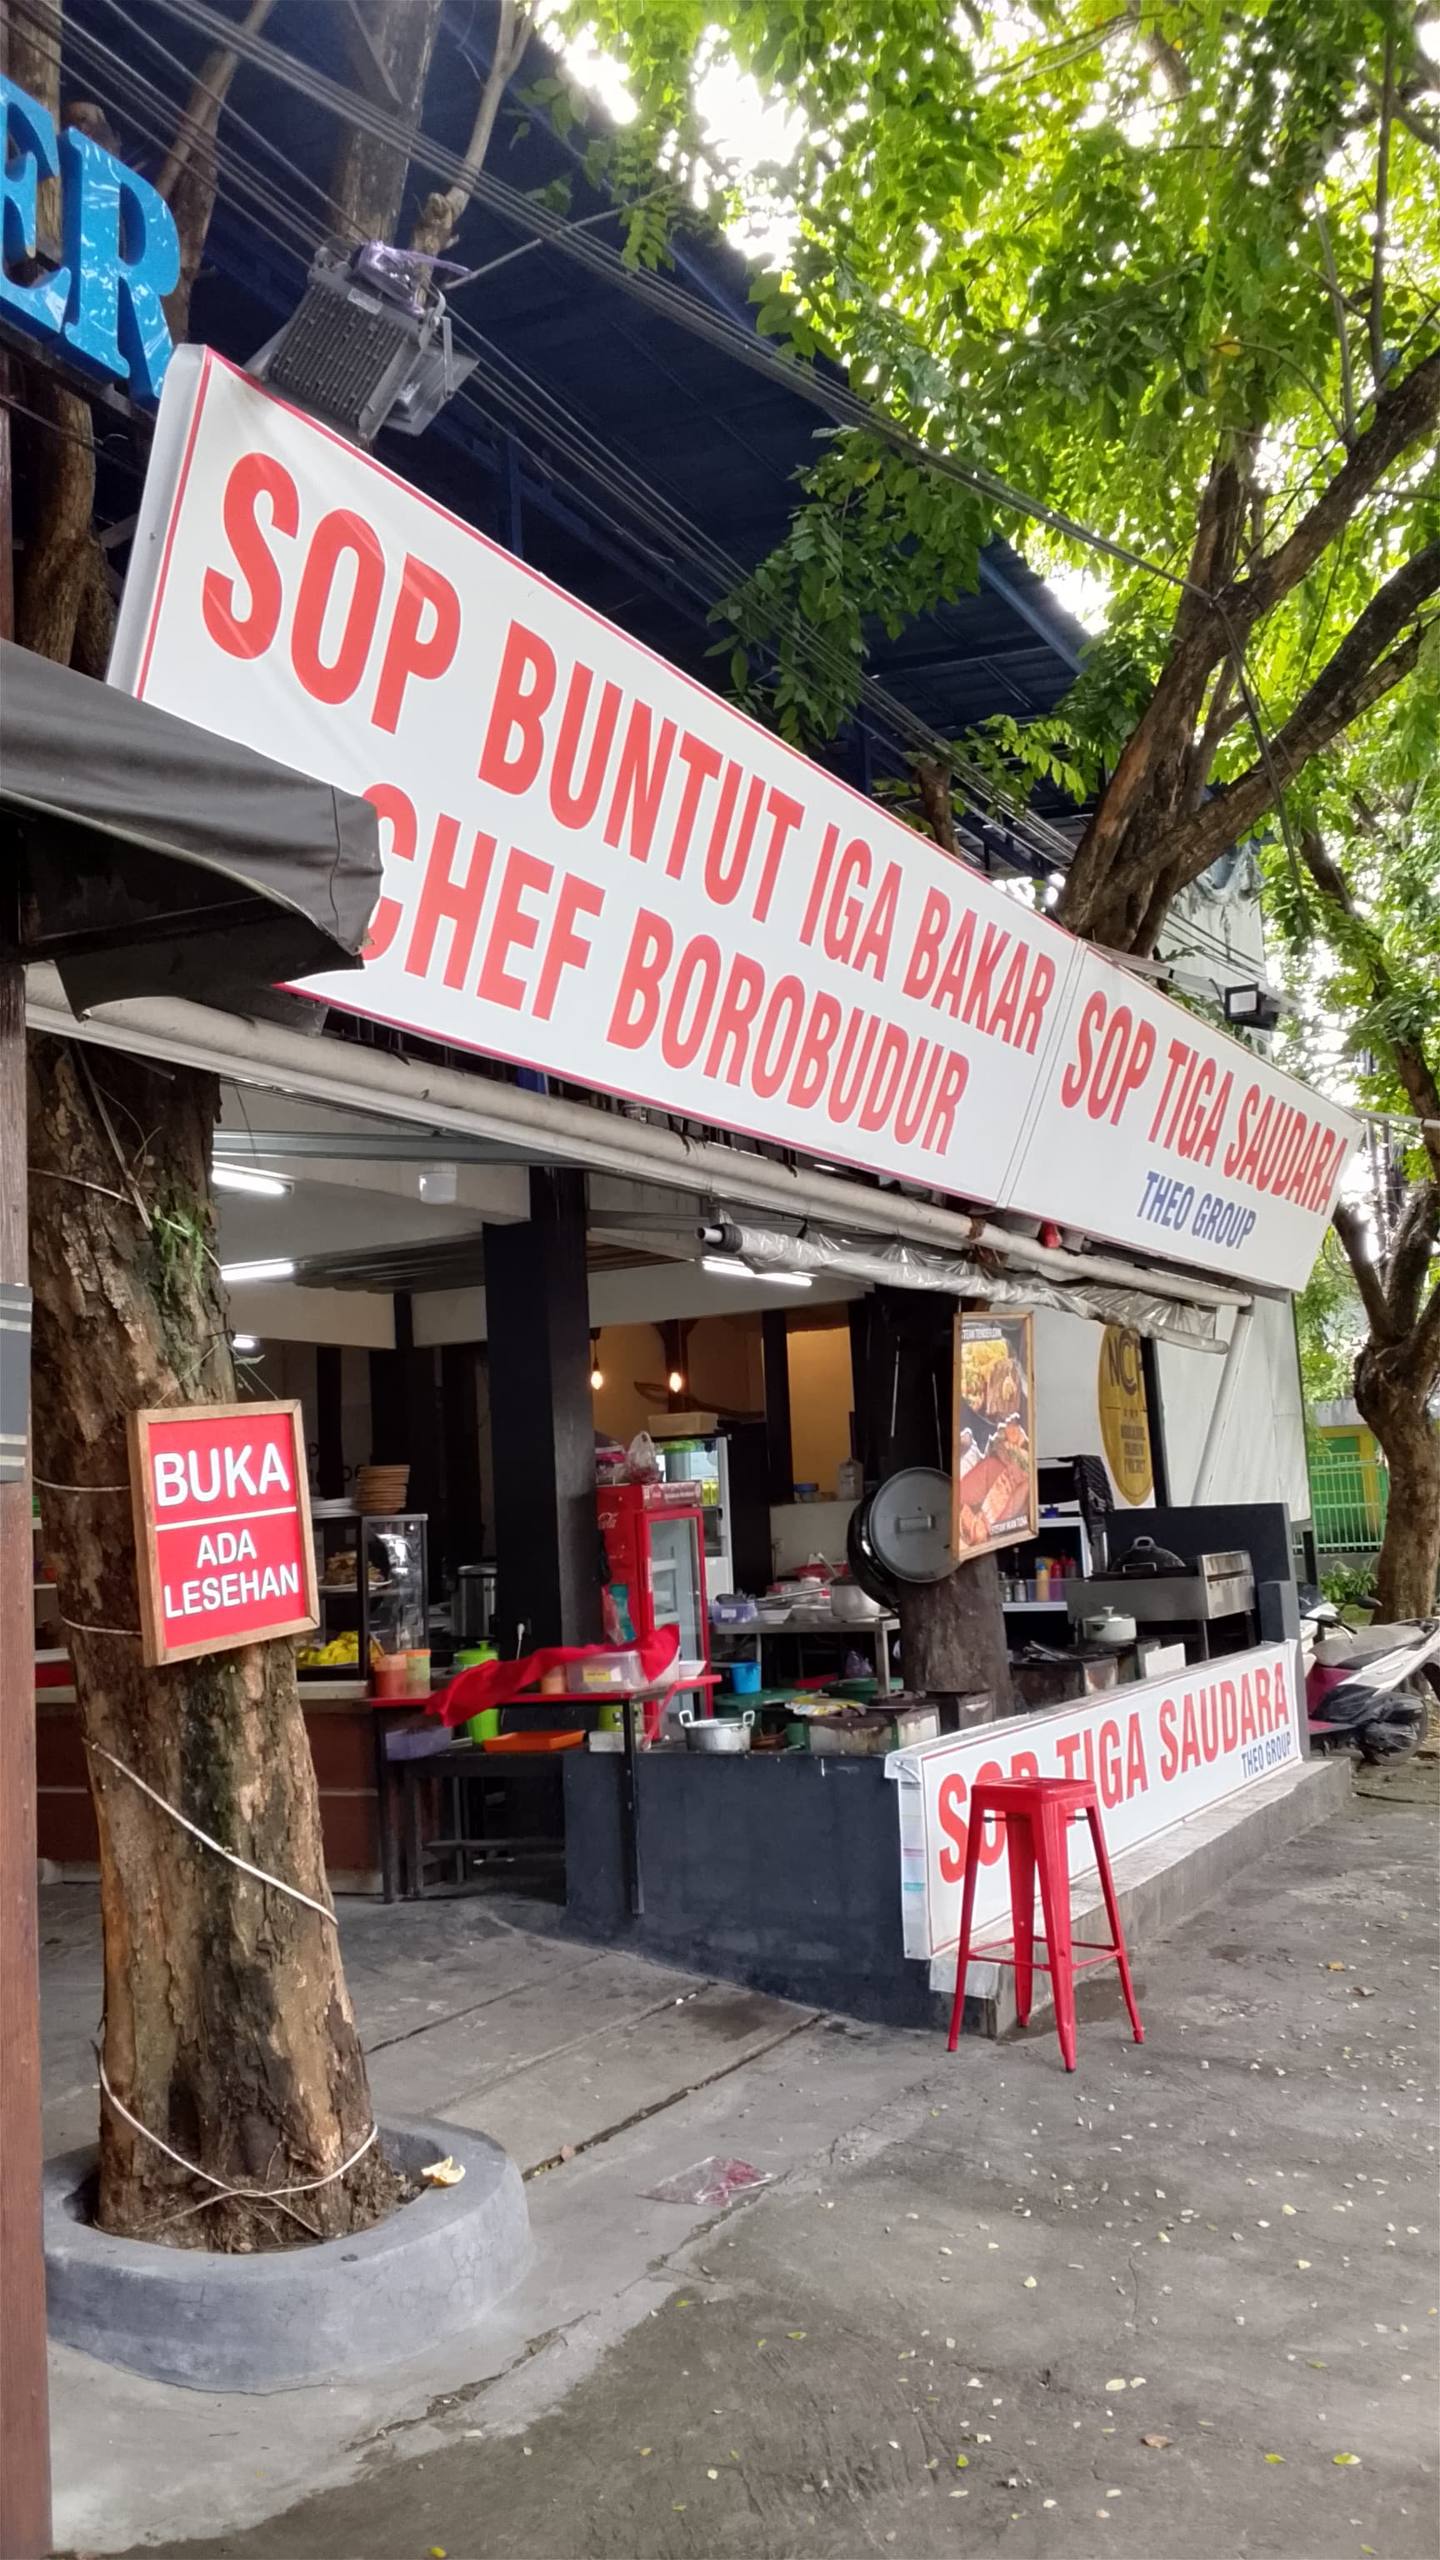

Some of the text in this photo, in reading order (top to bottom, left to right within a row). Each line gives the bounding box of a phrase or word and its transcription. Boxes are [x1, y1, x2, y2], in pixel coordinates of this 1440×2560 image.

[202, 452, 1057, 1055] SOP BUNTUT IGA BAKAR
[606, 907, 970, 1156] BOROBUDUR
[1060, 990, 1349, 1216] SOP TIGA SAUDARA
[1137, 1171, 1257, 1250] THEO GROUP
[154, 1443, 291, 1507] BUKA
[197, 1529, 257, 1569] ADA
[164, 1563, 299, 1619] LESEHAN
[1159, 1662, 1289, 1782] SAUDARA
[1242, 1732, 1291, 1778] THEO GROUP
